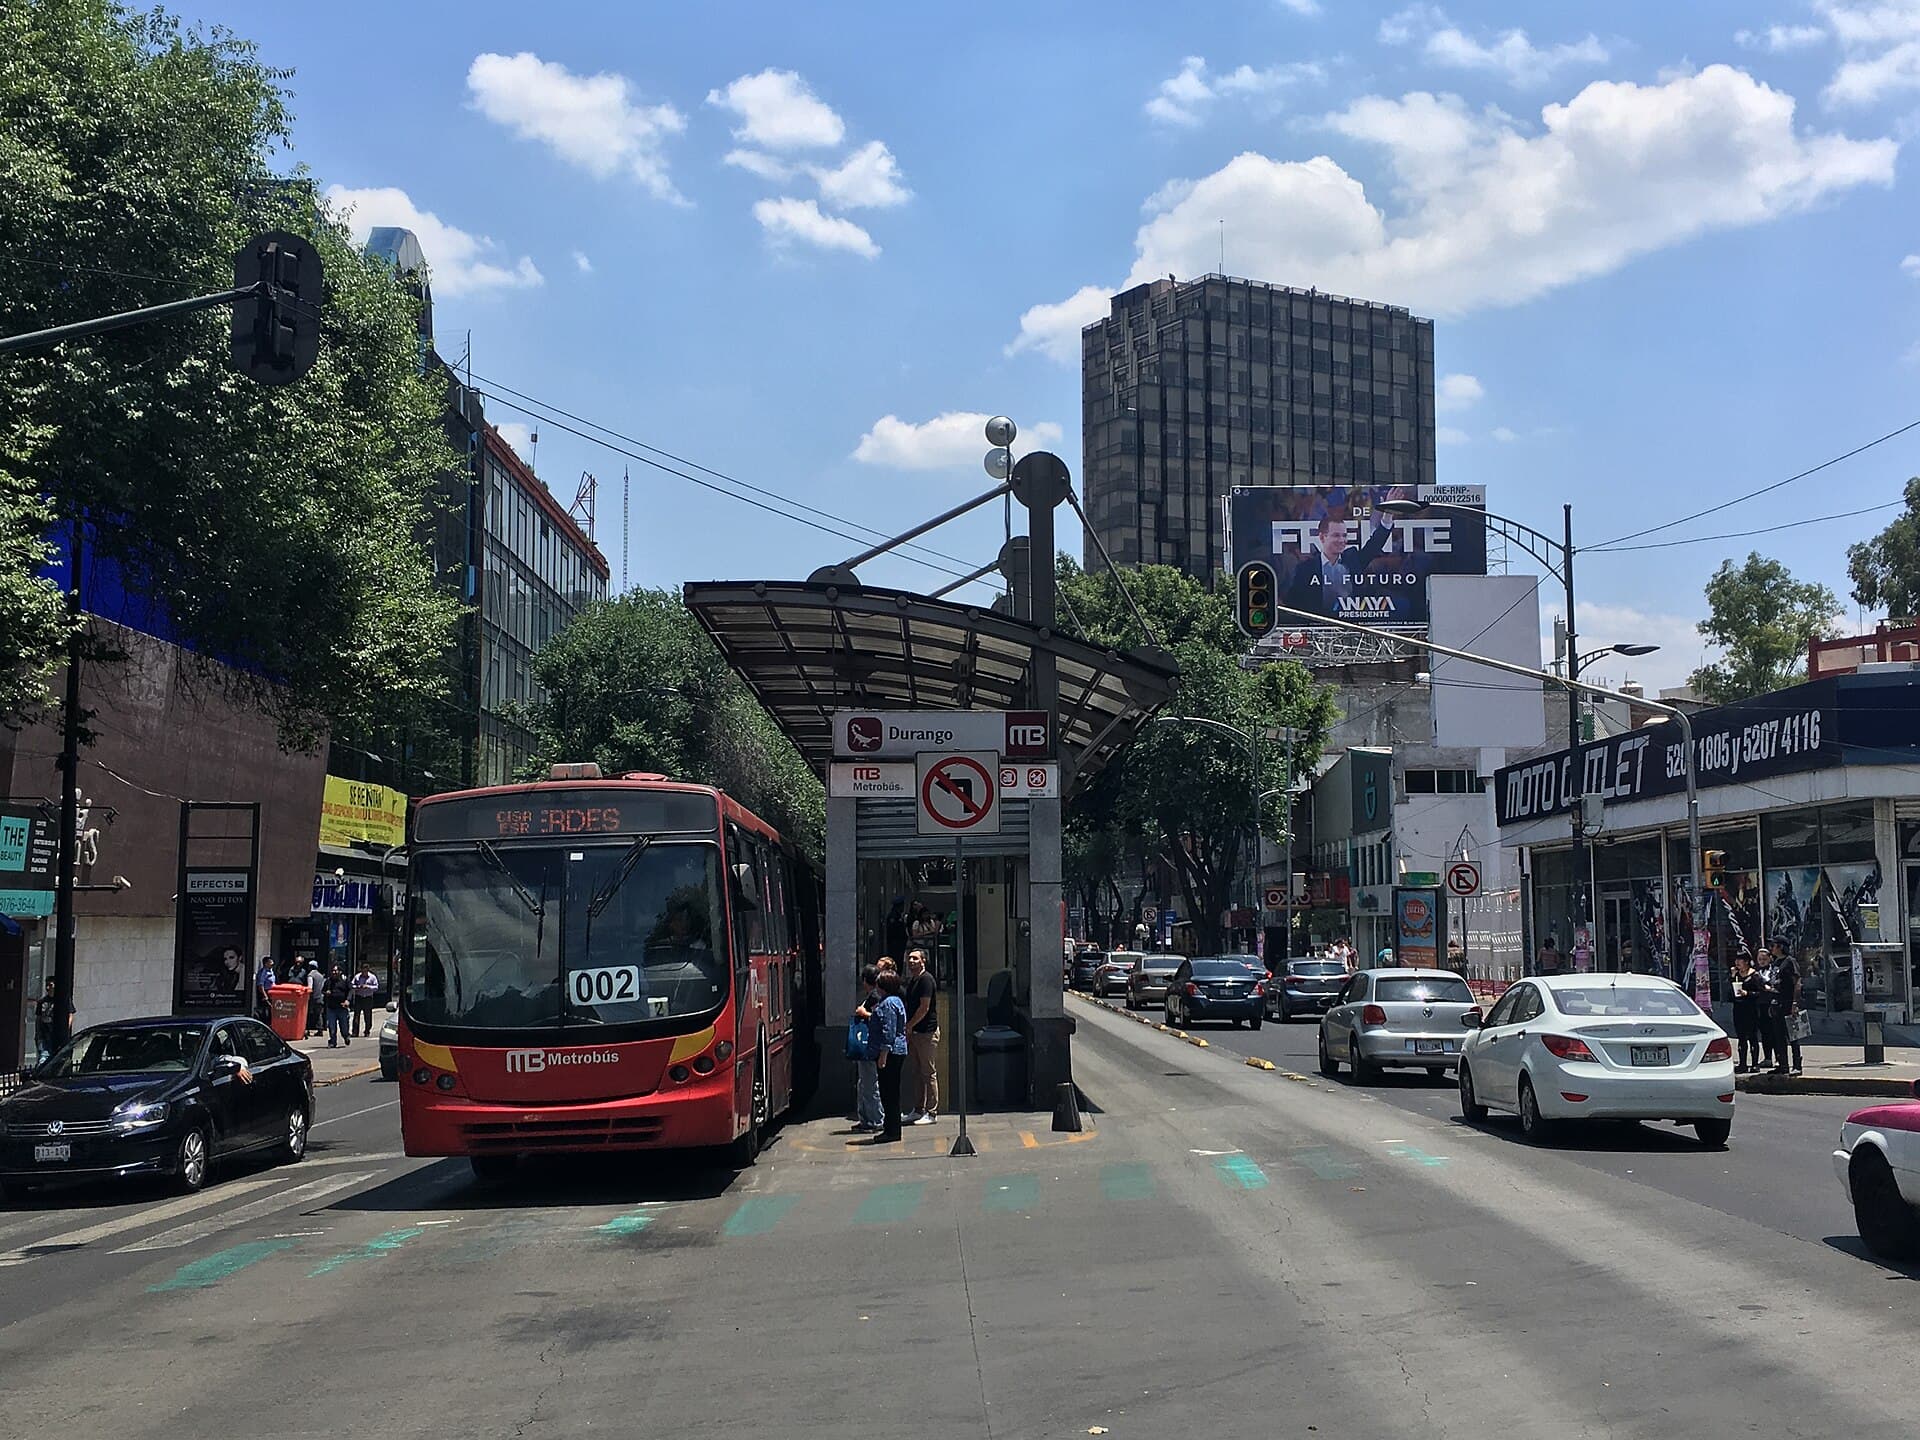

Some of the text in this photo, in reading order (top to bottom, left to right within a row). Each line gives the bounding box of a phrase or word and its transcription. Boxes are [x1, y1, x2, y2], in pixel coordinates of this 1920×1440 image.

[1352, 506, 1371, 517] DE
[1310, 574, 1417, 586] AL FUTURO
[1338, 610, 1390, 618] PRESIDENTE
[889, 726, 954, 745] Durango
[1699, 731, 1730, 772] 1805
[1731, 737, 1741, 775] y
[1743, 720, 1779, 763] 5207
[1781, 710, 1821, 755] 4116
[1505, 761, 1556, 819] MOTO
[3, 825, 25, 847] THE
[0, 850, 22, 862] BEAUTY
[190, 880, 234, 889] EFFECTS
[1267, 890, 1311, 906] OXO
[576, 968, 634, 1003] 002
[547, 1049, 620, 1066] Metrobús
